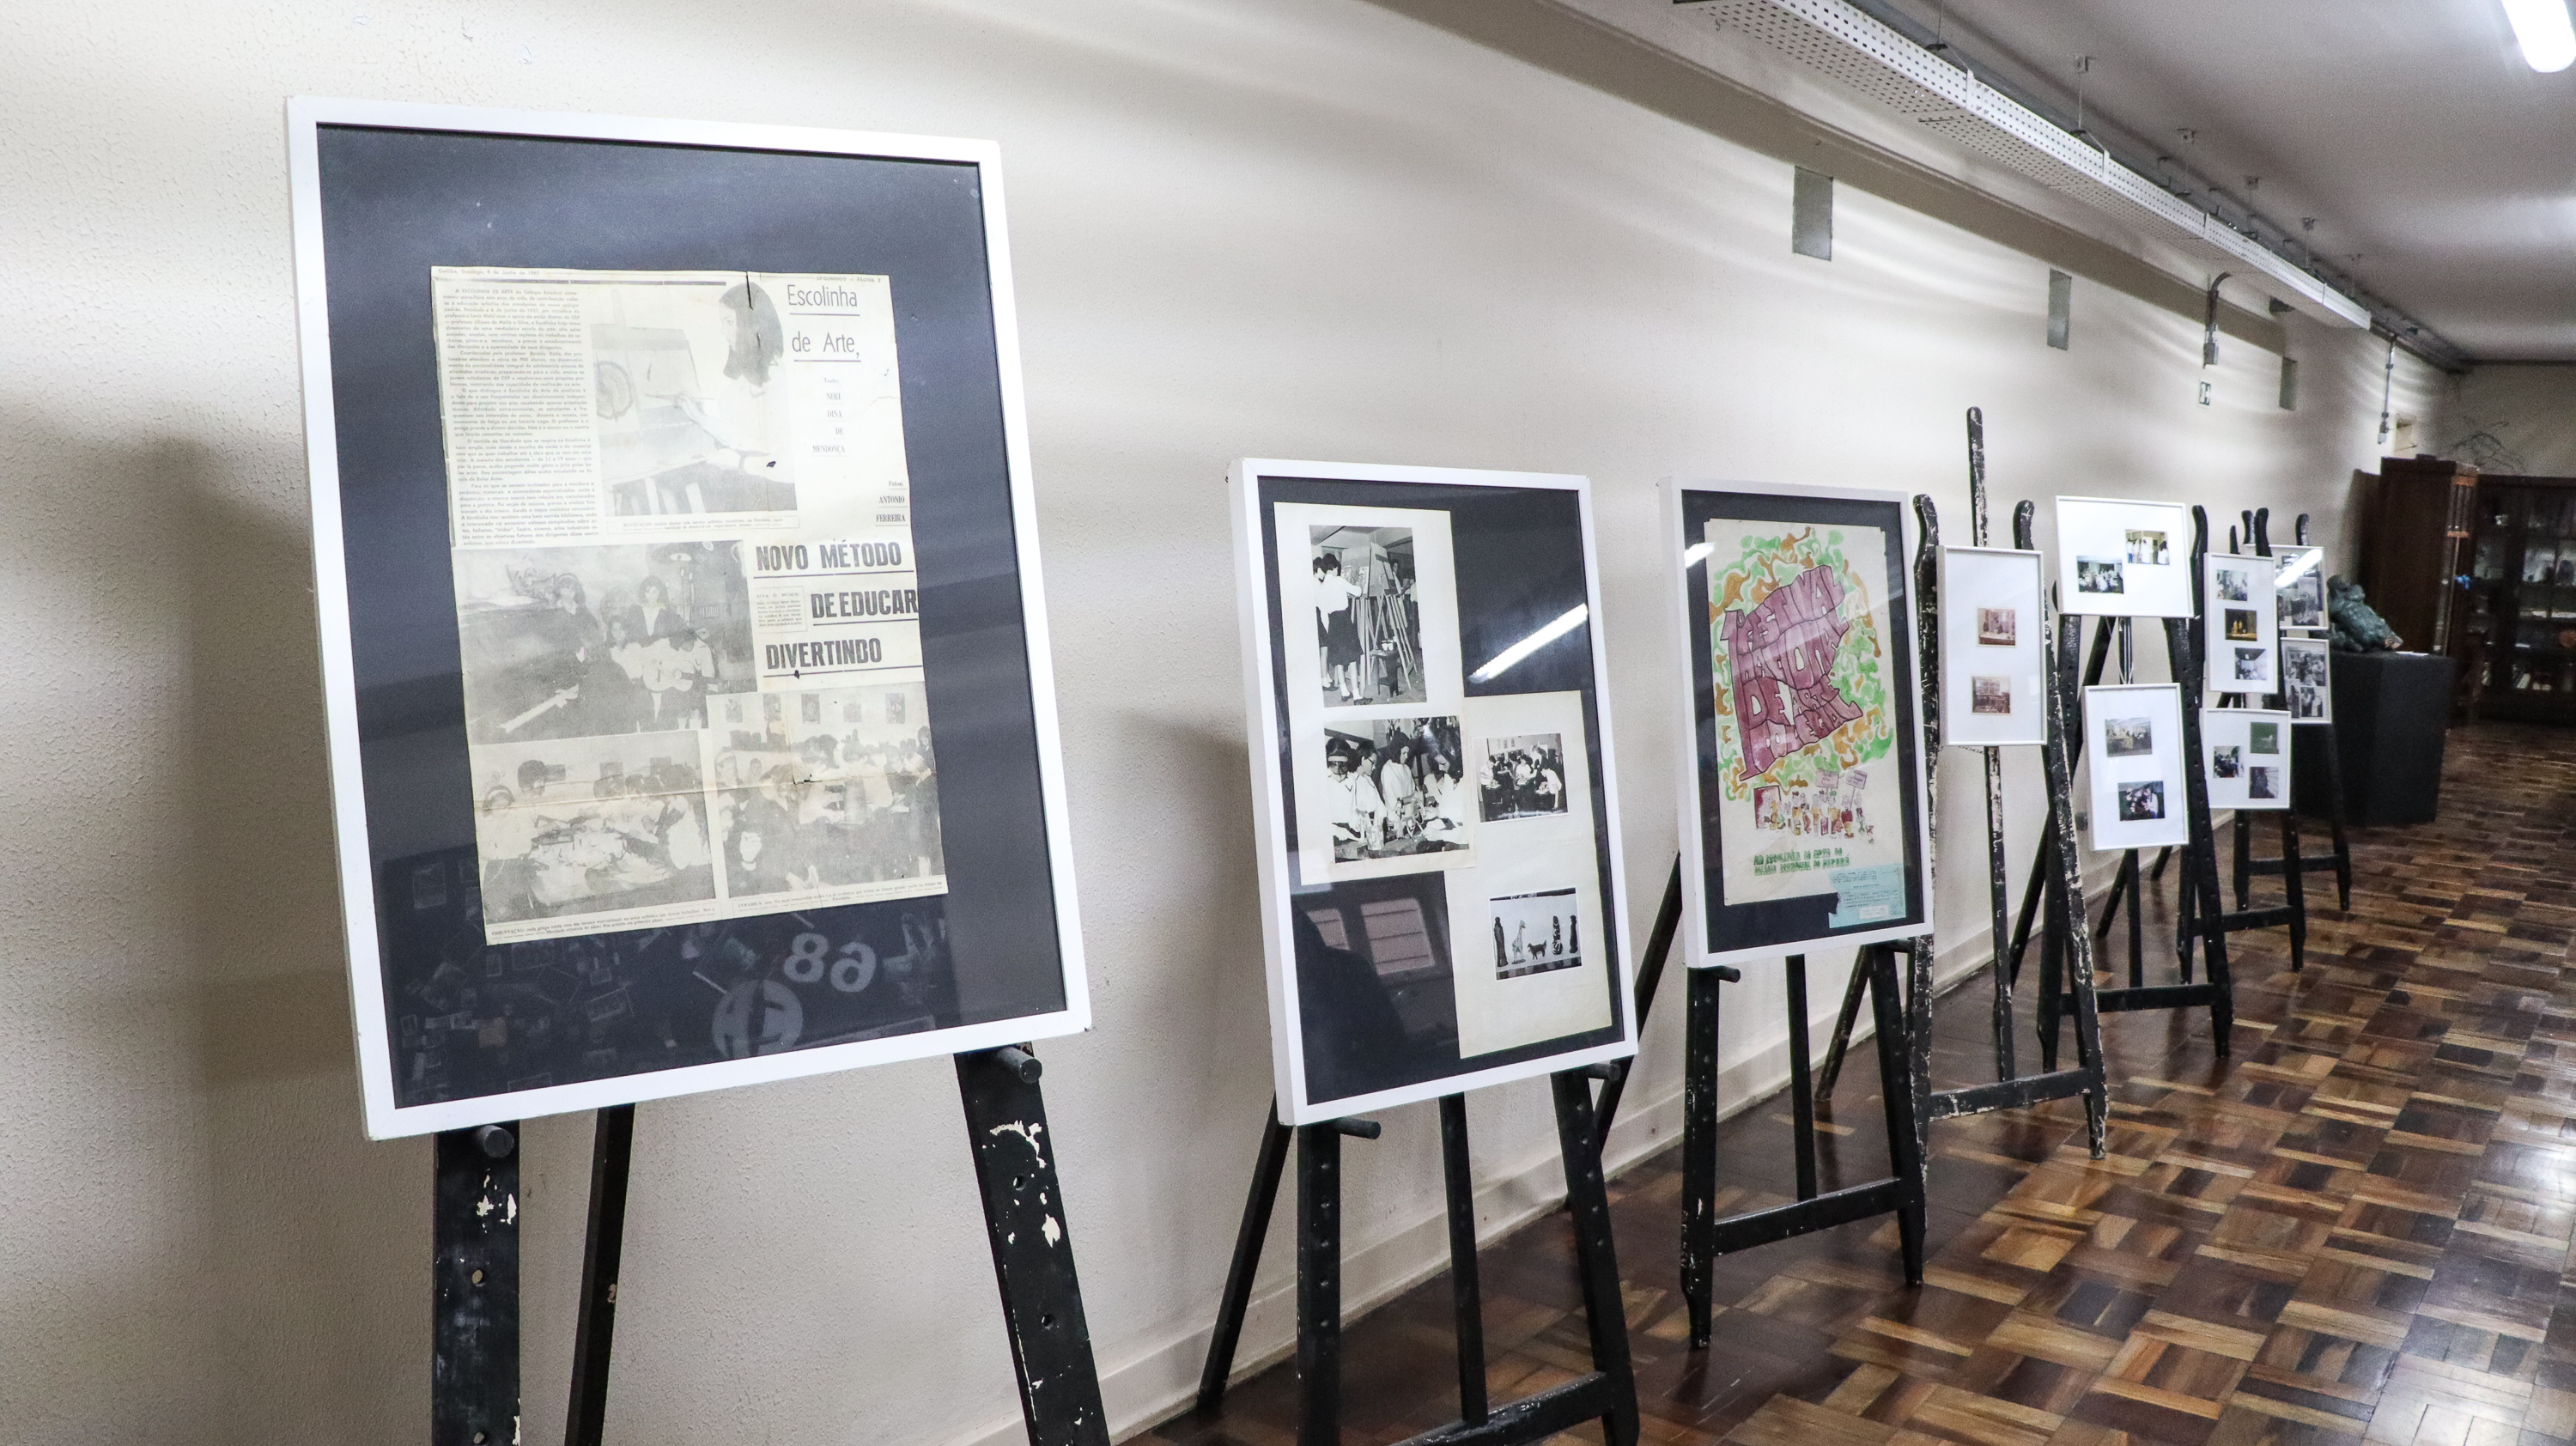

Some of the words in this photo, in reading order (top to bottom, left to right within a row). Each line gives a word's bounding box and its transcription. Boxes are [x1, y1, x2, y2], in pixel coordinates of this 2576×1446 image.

[787, 284, 858, 307] Escolinha
[792, 331, 811, 352] de
[823, 331, 860, 358] Arte,
[812, 445, 845, 454] MENDONÇA
[876, 514, 906, 523] FERREIRA
[756, 545, 808, 571] NOVO
[820, 540, 902, 568] MÉTODO
[811, 593, 837, 618] DE
[839, 589, 918, 617] EDUCAR
[766, 638, 882, 669] DIVERTINDO
[1743, 677, 1795, 730] DE
[1791, 674, 1839, 718] ARTE
